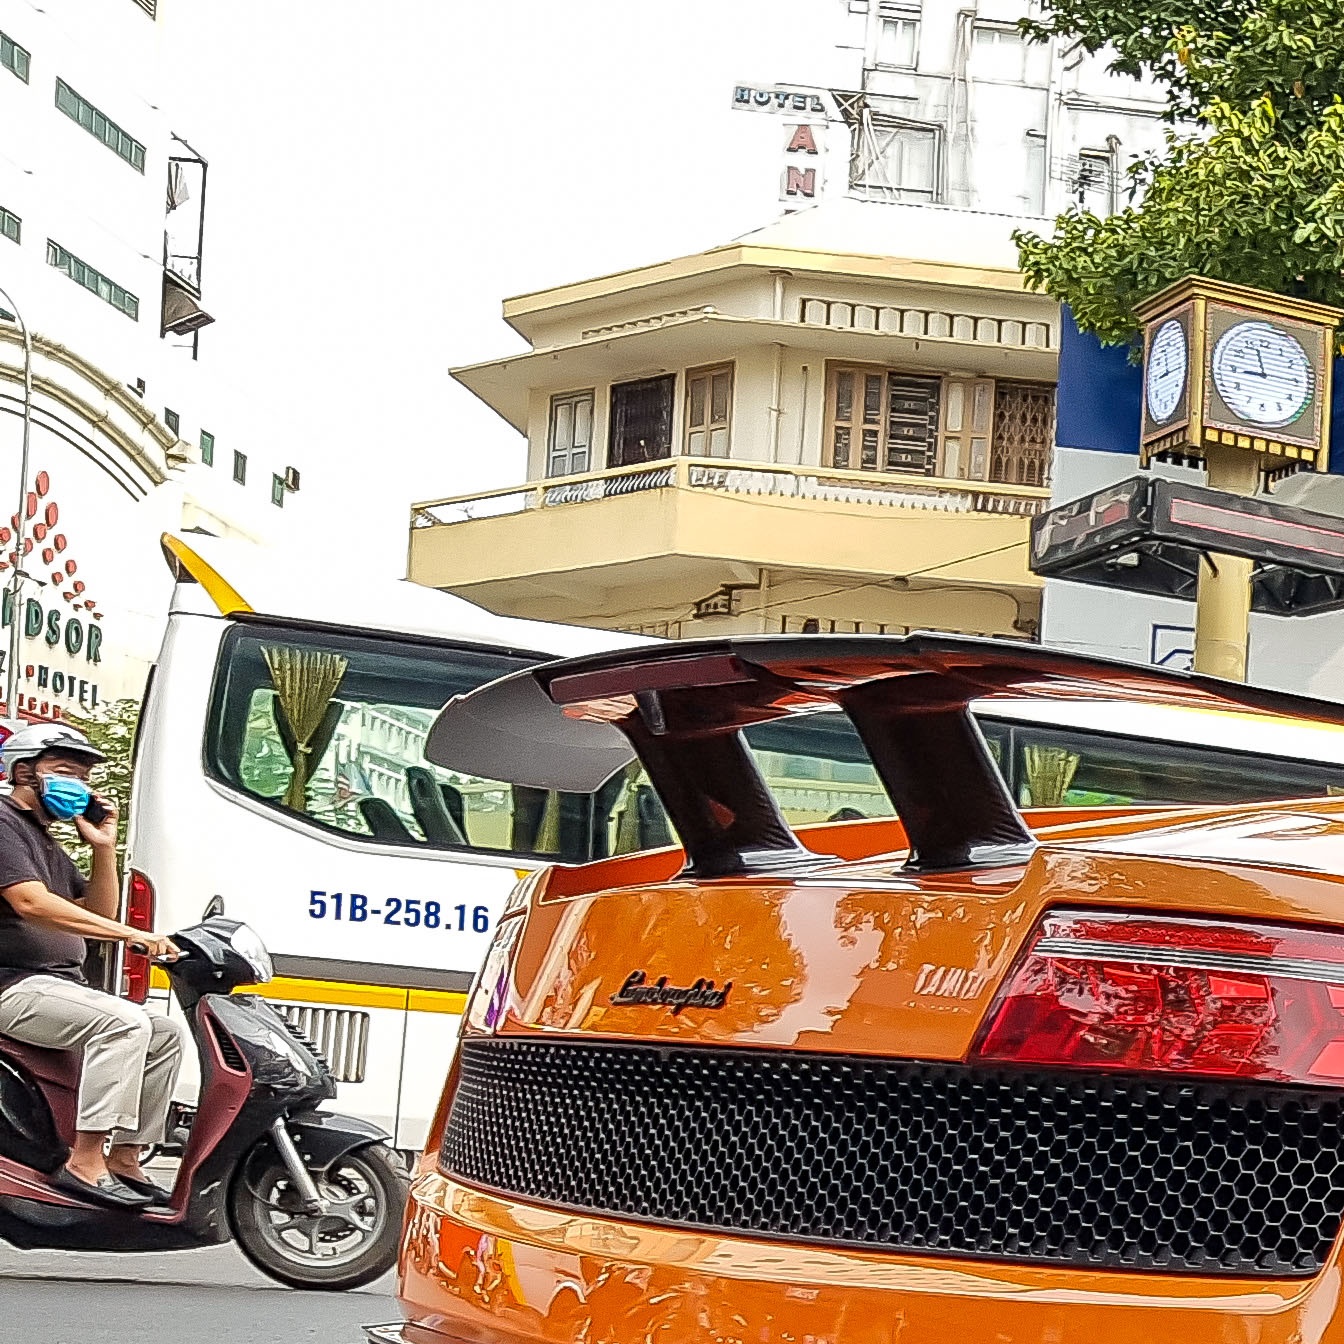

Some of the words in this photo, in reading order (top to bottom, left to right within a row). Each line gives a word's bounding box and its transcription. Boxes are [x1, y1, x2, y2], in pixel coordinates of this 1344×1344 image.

[735, 86, 825, 112] HOTEL
[38, 664, 99, 706] HOTEL
[308, 890, 489, 934] 51B-258.16
